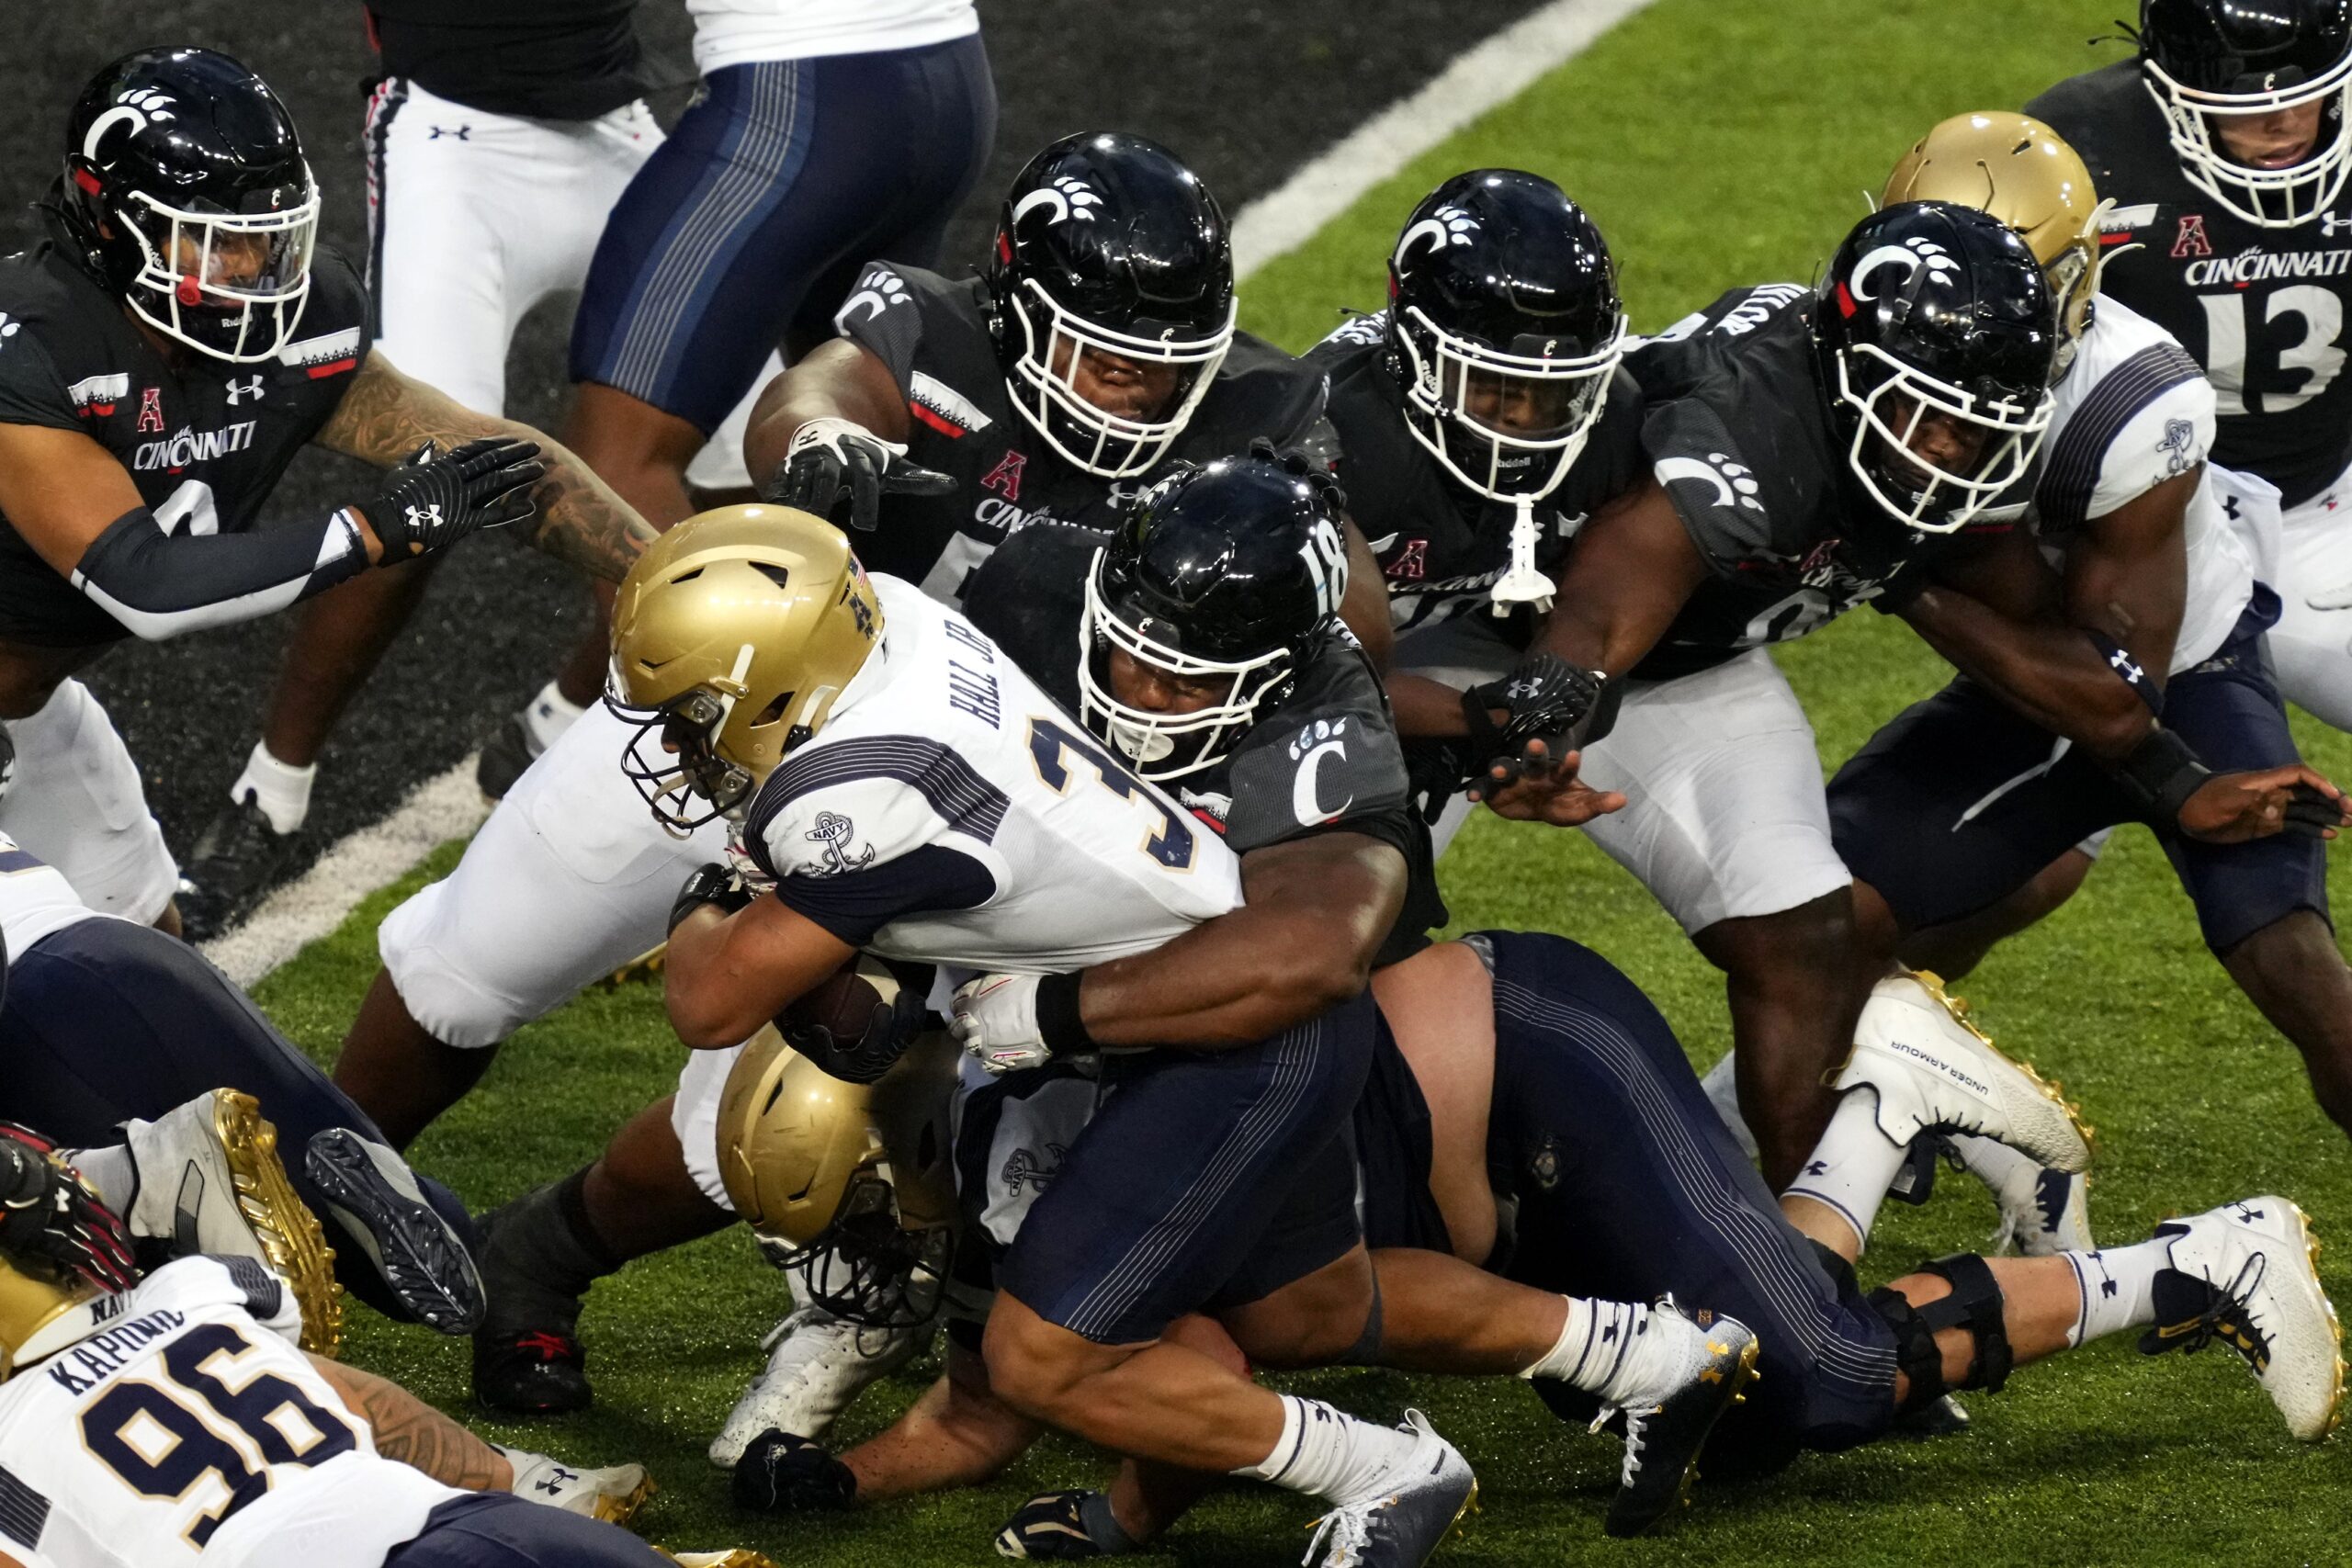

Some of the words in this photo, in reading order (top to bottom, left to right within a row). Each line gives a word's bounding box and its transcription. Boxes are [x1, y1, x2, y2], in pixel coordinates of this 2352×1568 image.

[2171, 215, 2211, 257] A
[2185, 245, 2351, 287] CINCINNATI
[2197, 285, 2347, 415] 13
[137, 388, 164, 432] A
[980, 449, 1028, 501] A
[1298, 519, 1349, 618] 18
[949, 659, 1001, 730] HALL
[813, 822, 843, 839] NAVY
[1891, 1041, 1949, 1071] ARMOUR
[1950, 1067, 1989, 1096] UNDER
[1012, 1156, 1023, 1190] NAVY
[75, 1322, 360, 1554] 96
